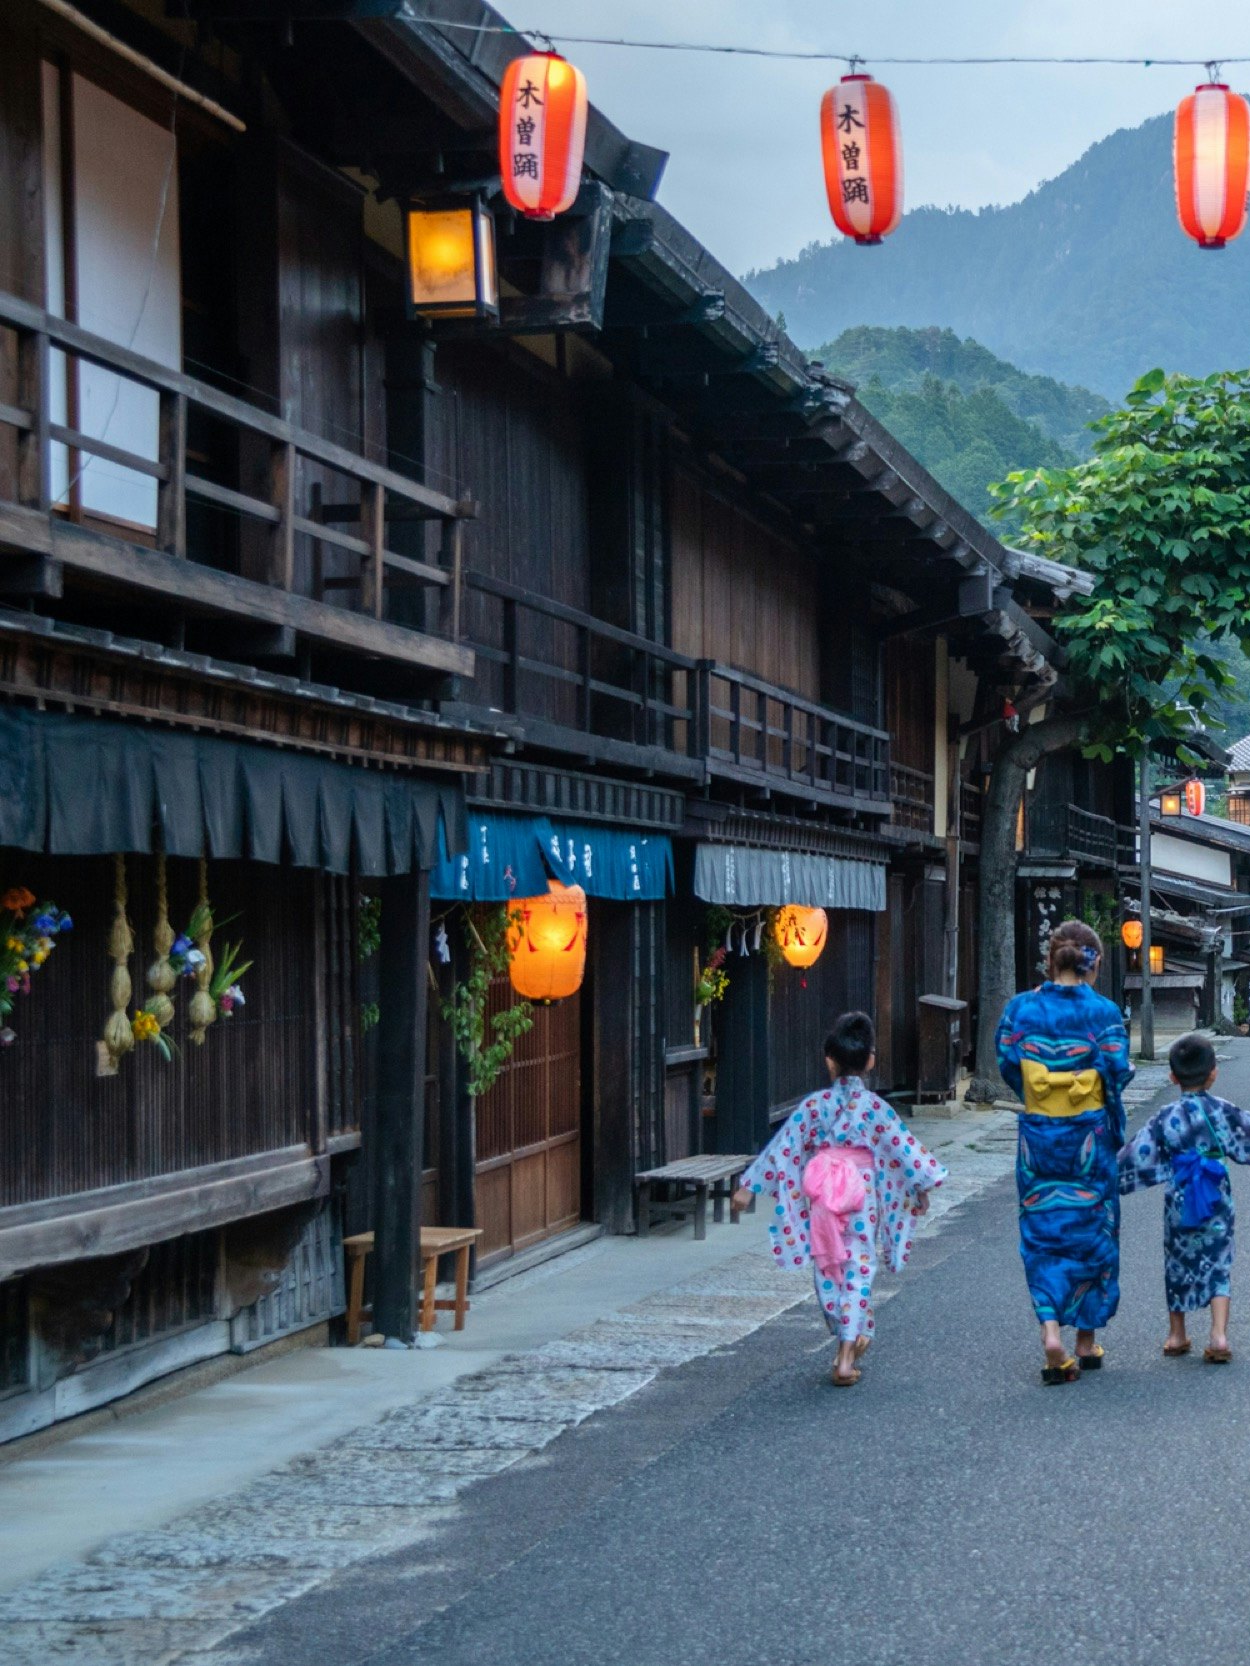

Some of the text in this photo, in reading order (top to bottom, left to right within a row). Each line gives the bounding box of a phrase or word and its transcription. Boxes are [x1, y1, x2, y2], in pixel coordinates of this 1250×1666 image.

[513, 80, 544, 181] 木曽踊
[837, 104, 870, 205] 木曽踊
